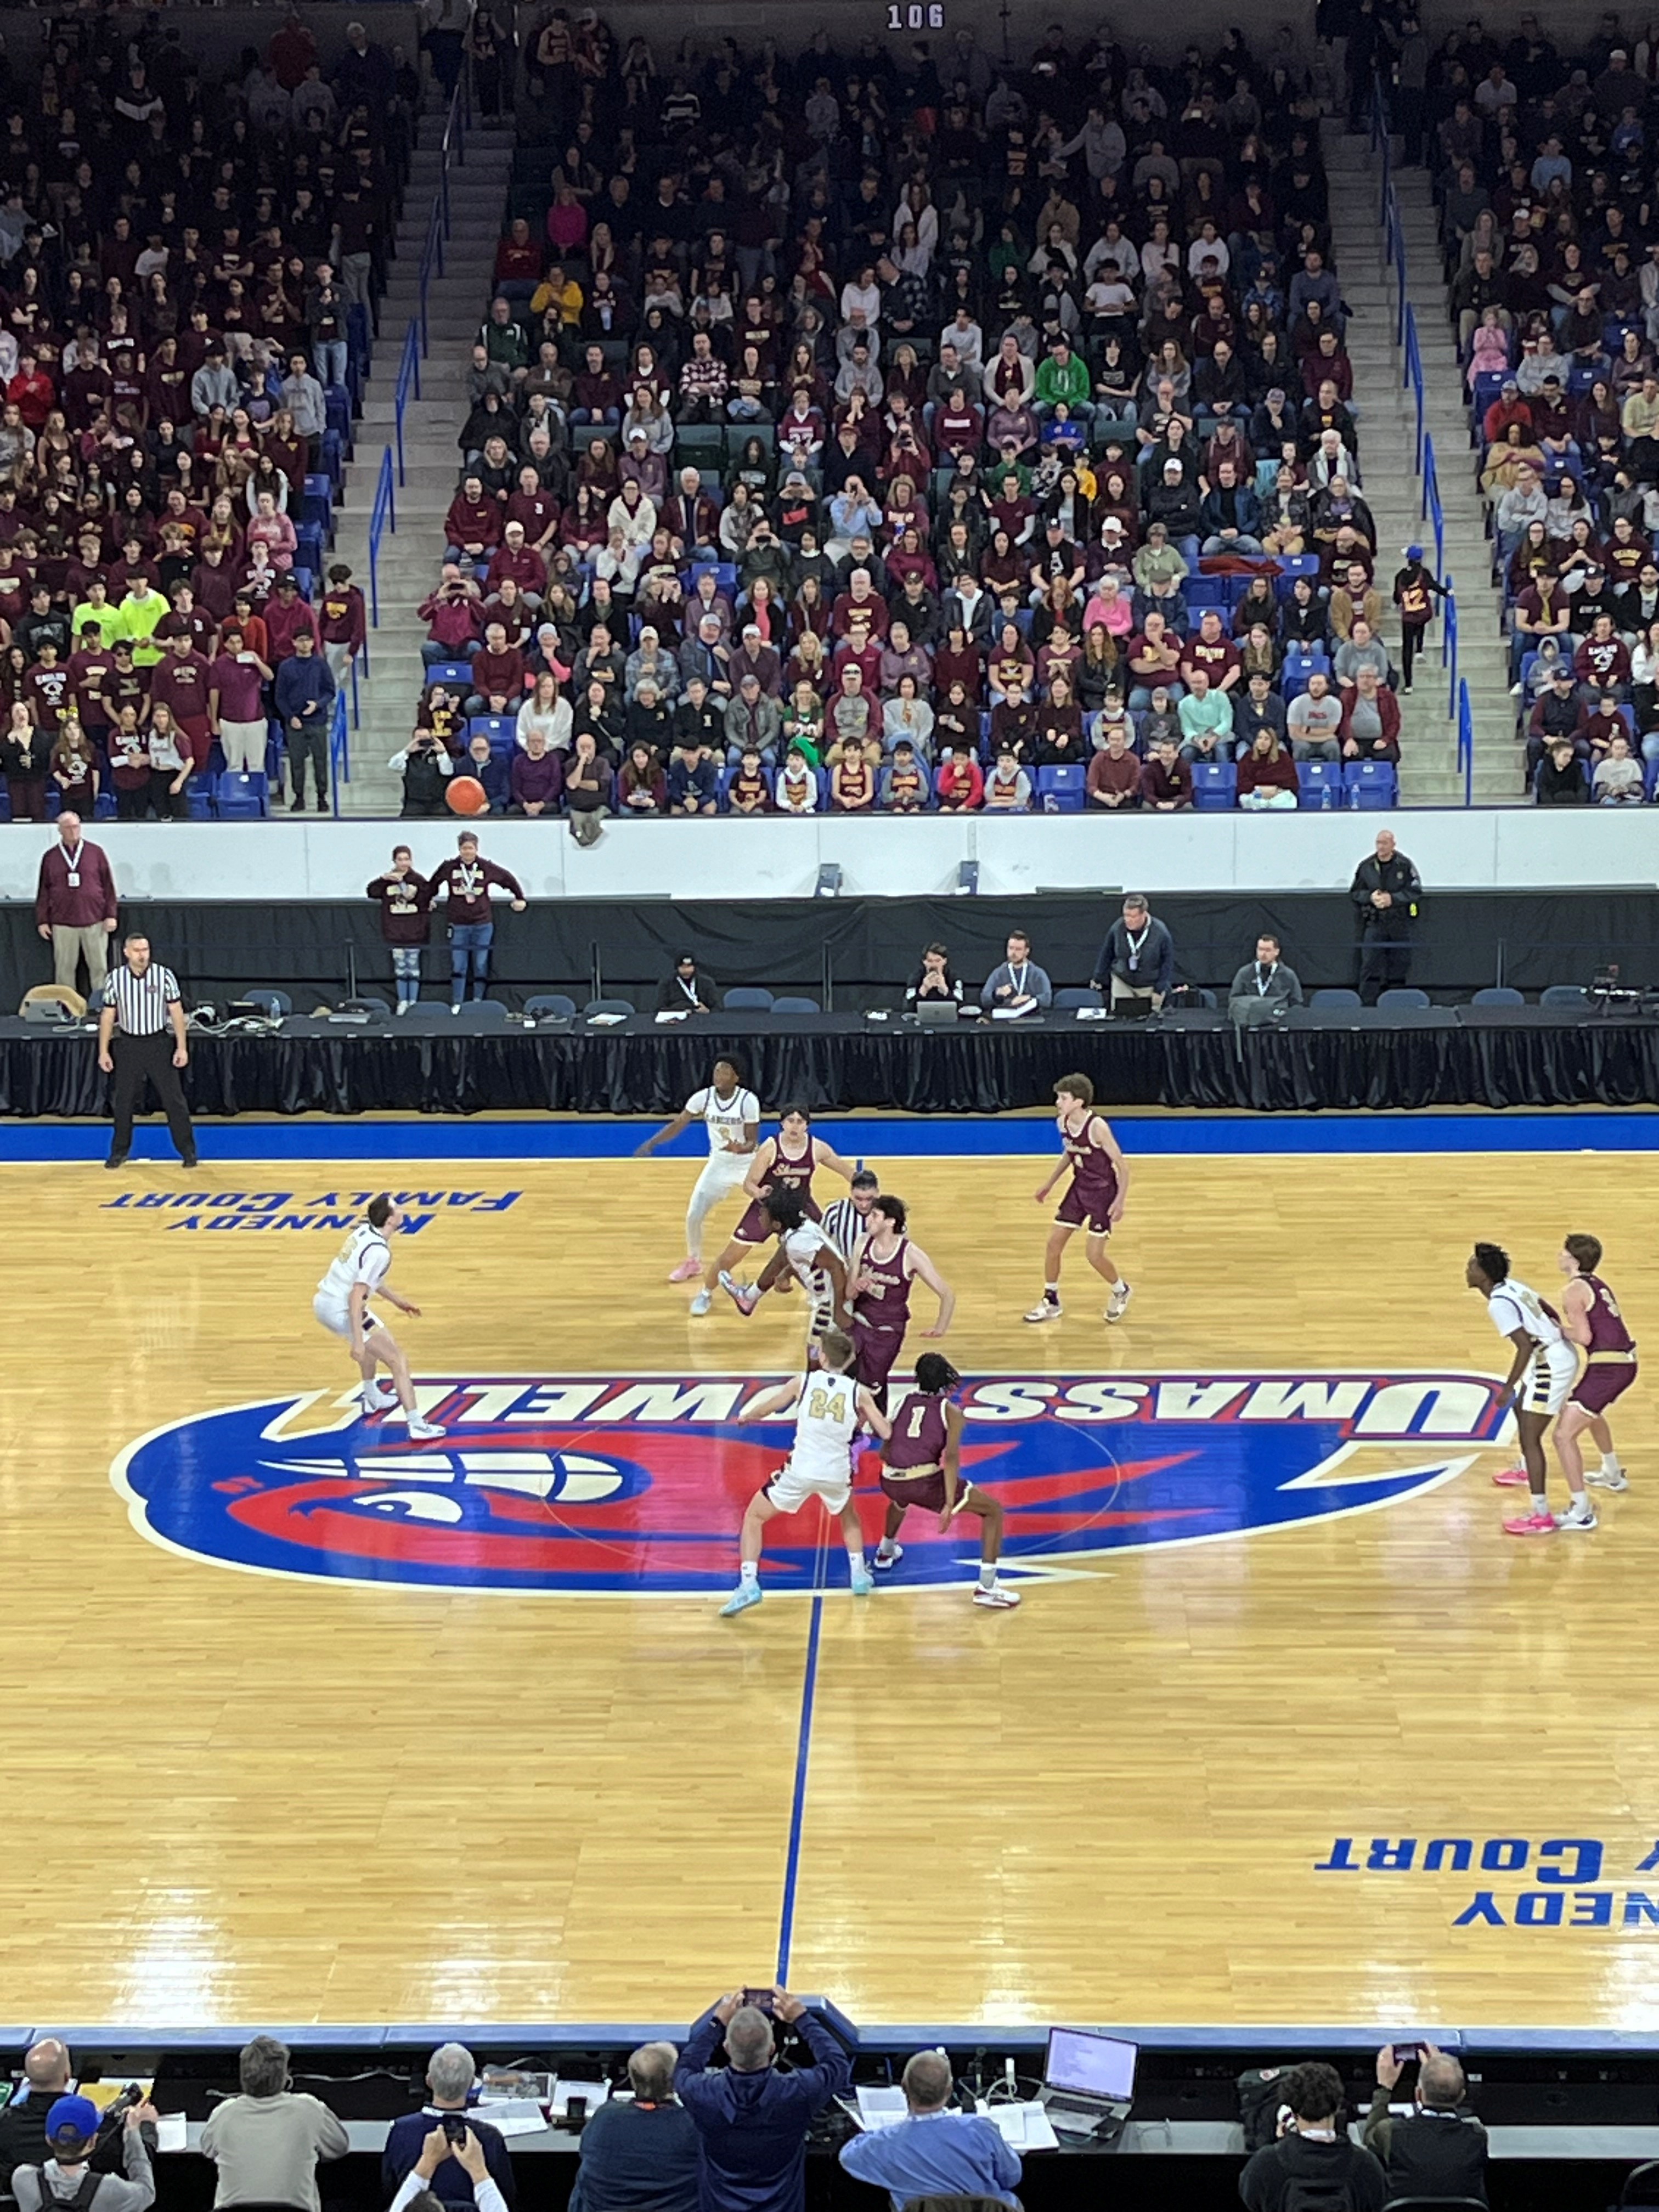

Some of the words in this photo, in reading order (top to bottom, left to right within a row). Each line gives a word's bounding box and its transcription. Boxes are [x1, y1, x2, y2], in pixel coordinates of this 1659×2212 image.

[888, 4, 944, 29] 106
[1402, 588, 1426, 612] 12
[99, 1192, 294, 1213] COURT
[166, 1213, 437, 1235] KNNEDY
[809, 1387, 847, 1424] 24
[964, 1381, 1489, 1434] UMASS
[907, 1406, 926, 1433] 1
[1314, 1838, 1604, 1884] COURT
[1451, 1892, 1659, 1927] NEDY
